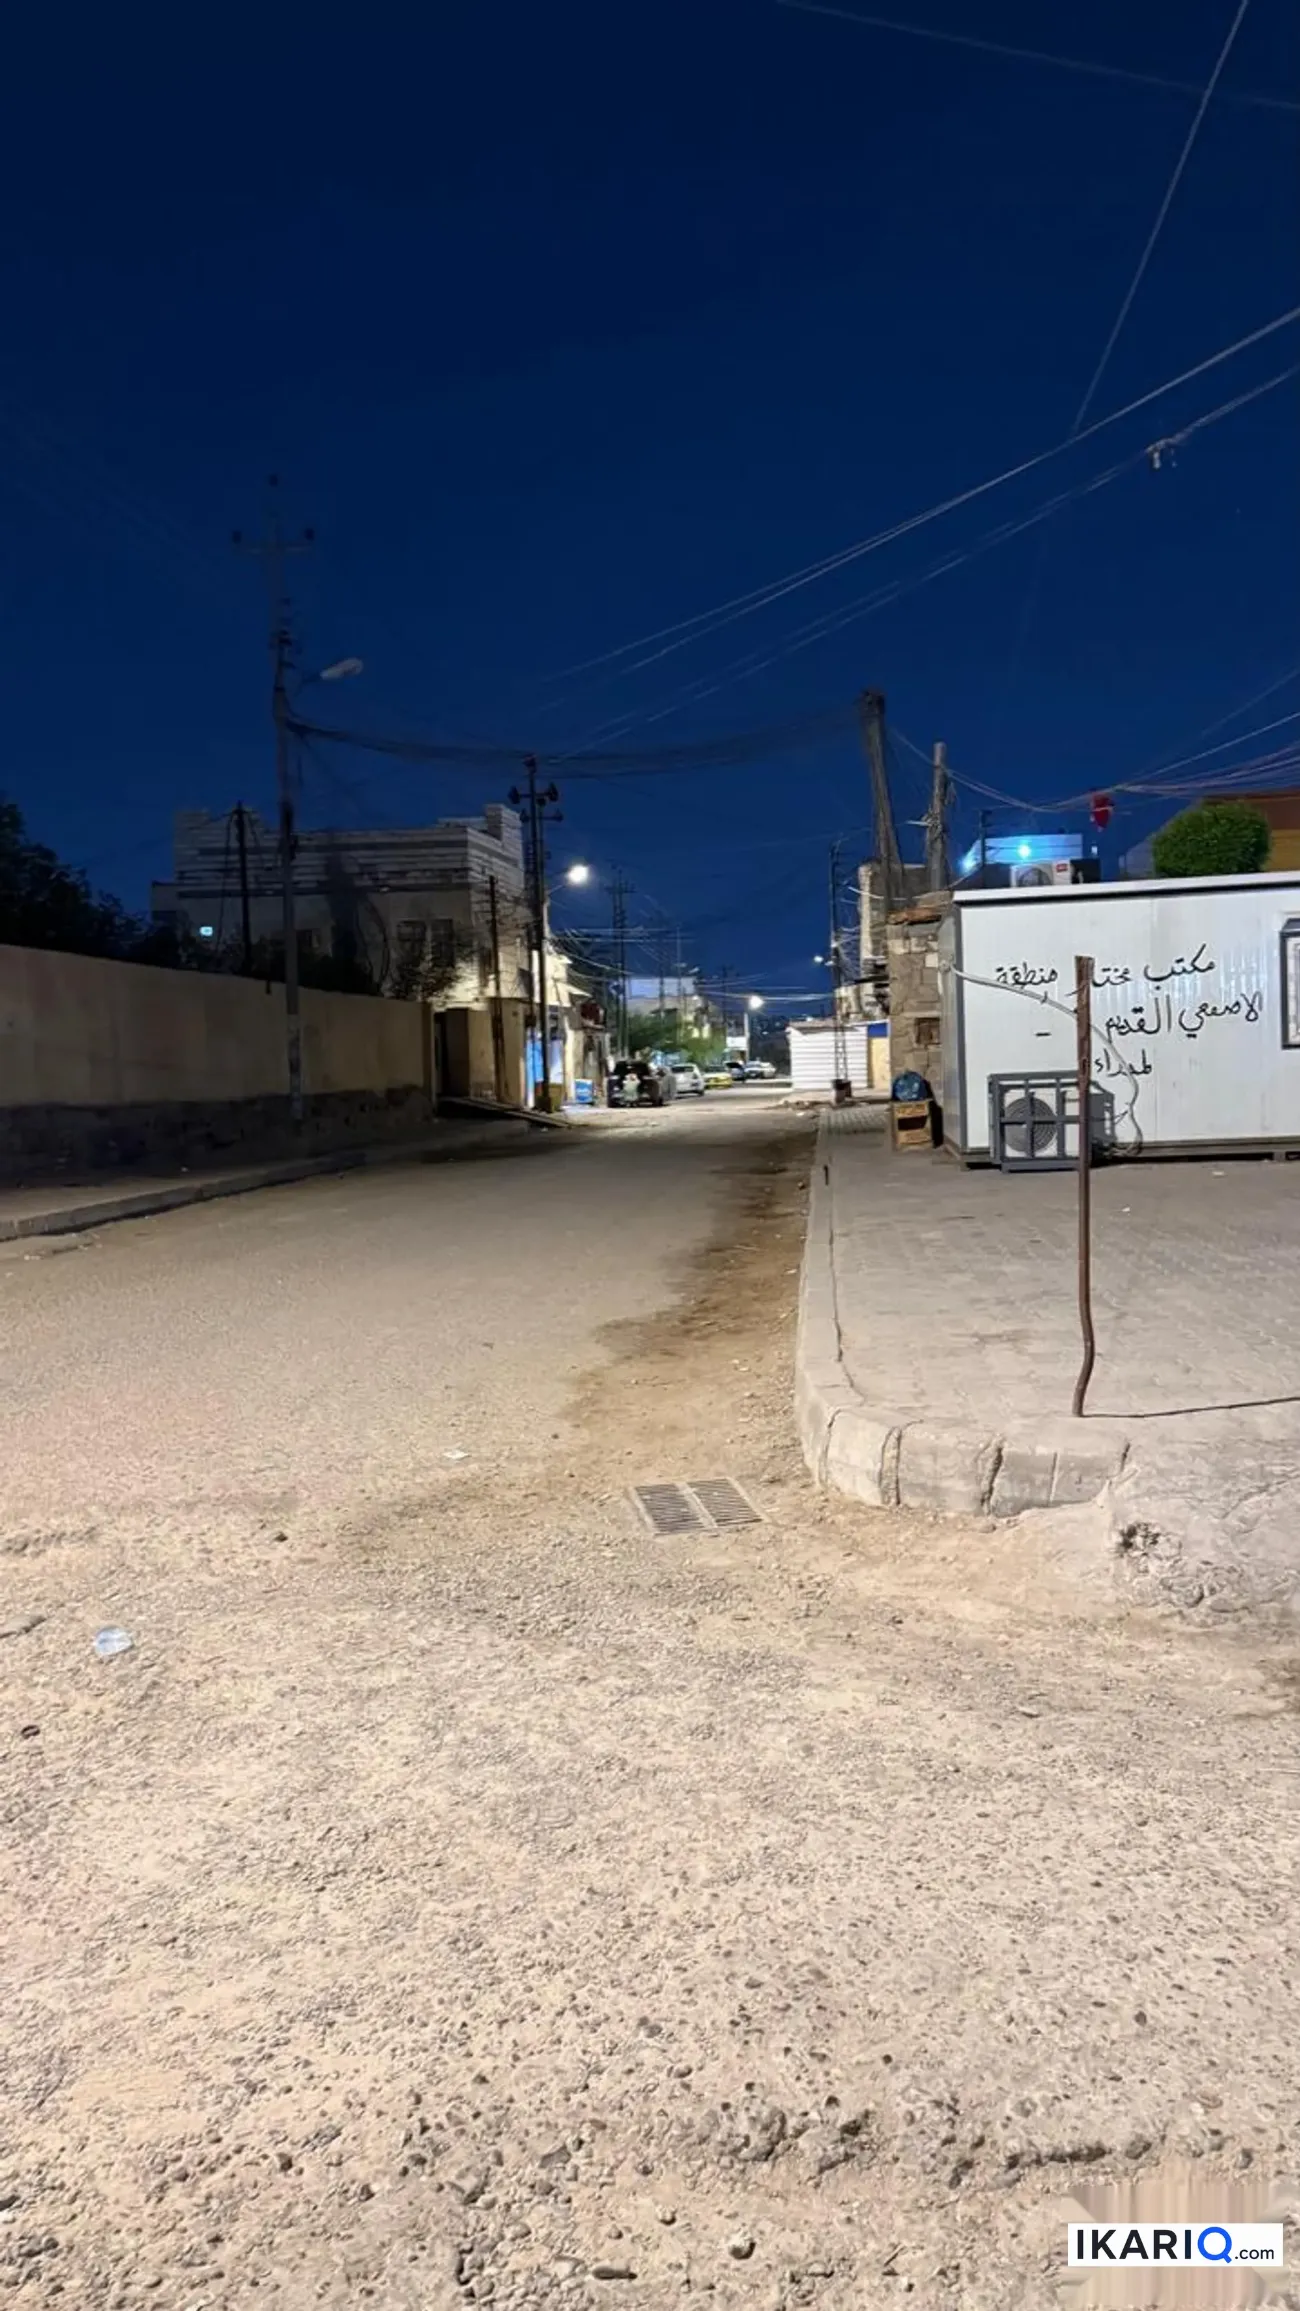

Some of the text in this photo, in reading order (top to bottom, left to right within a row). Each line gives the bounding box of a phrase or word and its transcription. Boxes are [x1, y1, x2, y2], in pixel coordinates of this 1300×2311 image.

[995, 943, 1216, 997] مكتب مختر منطقة
